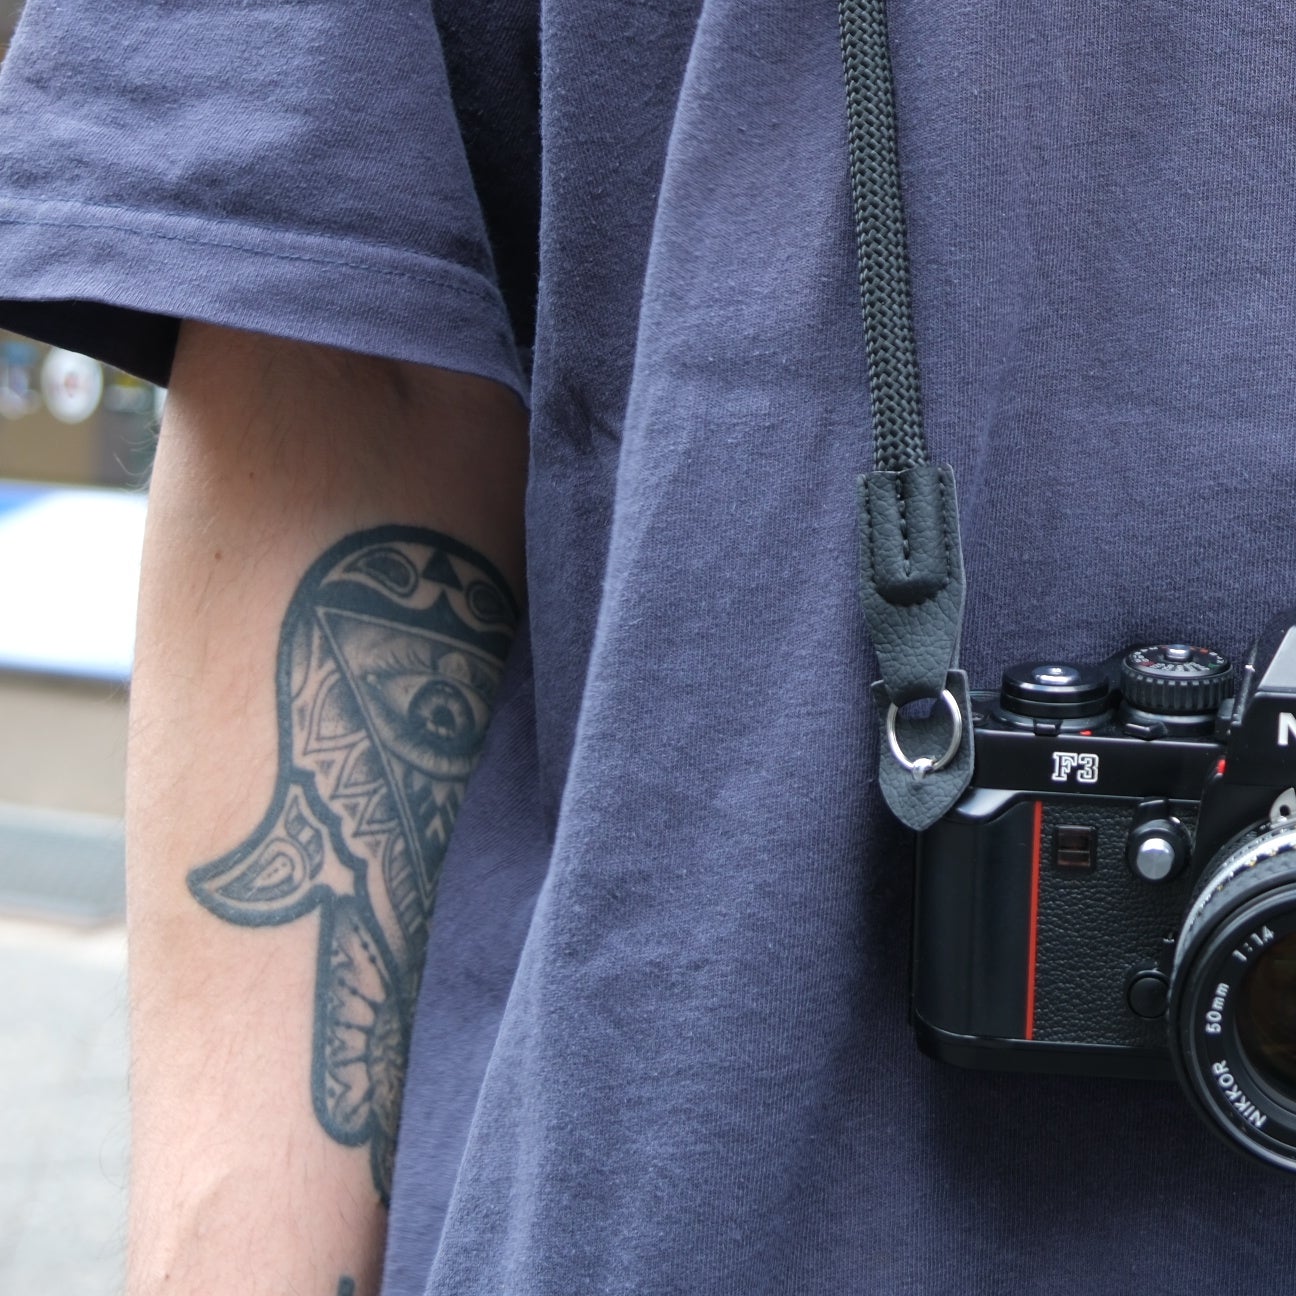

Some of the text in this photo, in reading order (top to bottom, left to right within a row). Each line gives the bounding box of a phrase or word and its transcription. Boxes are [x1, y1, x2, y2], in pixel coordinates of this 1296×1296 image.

[1051, 751, 1100, 784] F3
[1205, 982, 1230, 1035] 50mm
[1211, 1059, 1267, 1128] NIKKOR
